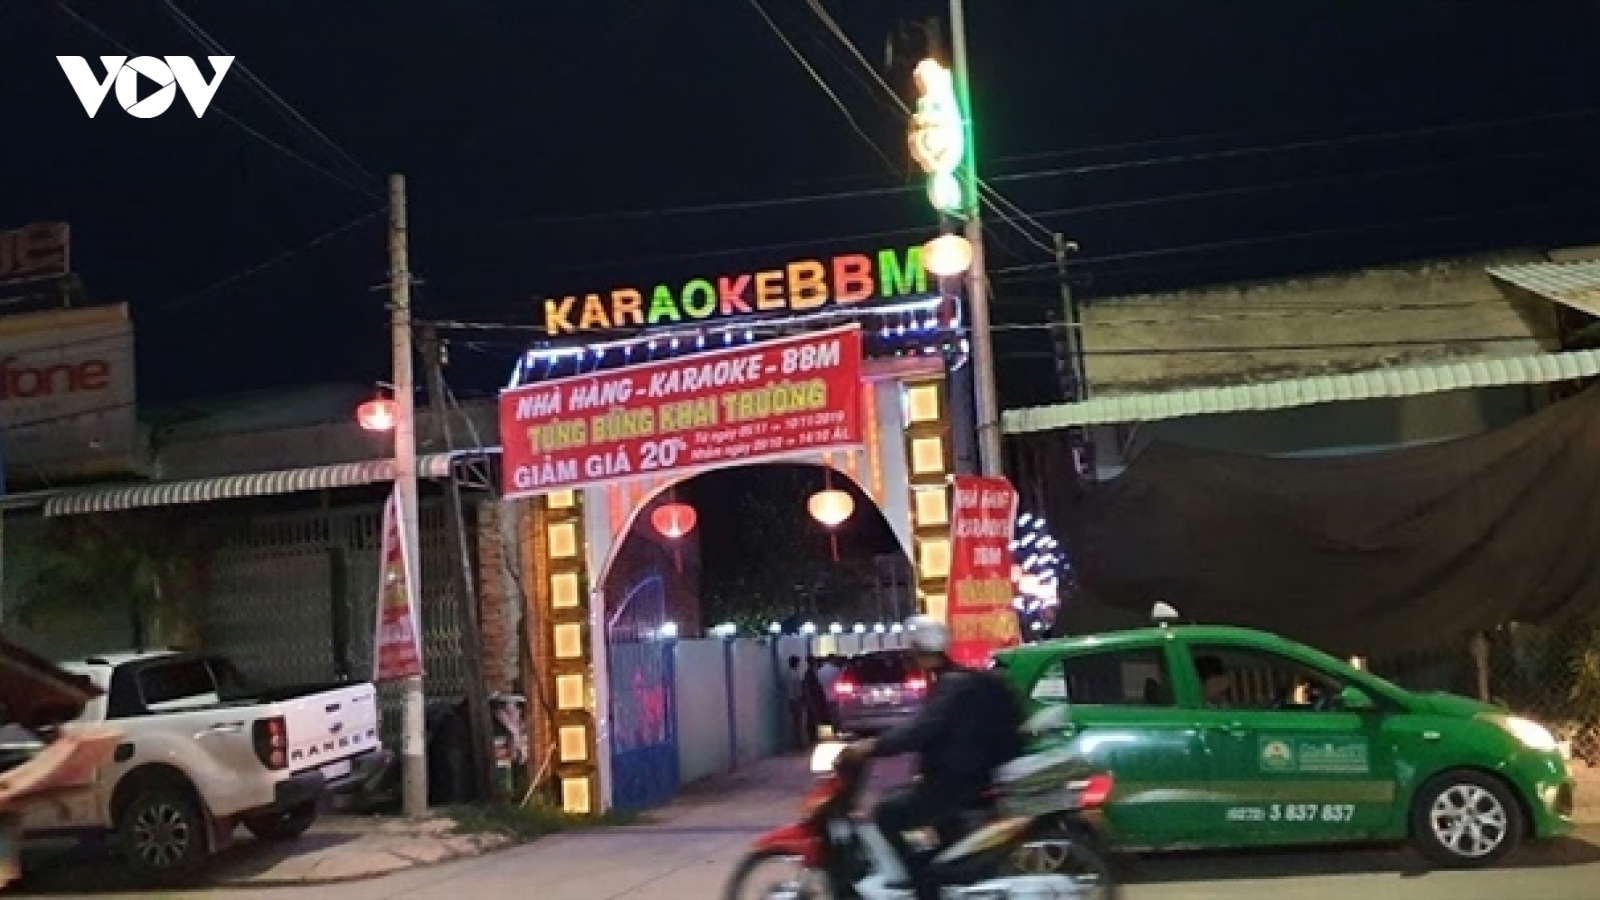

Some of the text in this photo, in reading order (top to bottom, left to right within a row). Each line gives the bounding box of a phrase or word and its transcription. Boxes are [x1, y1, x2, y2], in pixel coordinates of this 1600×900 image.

[516, 386, 562, 421] NHÀ
[569, 378, 633, 411] HÀNG
[649, 354, 765, 397] KARAOKE
[782, 339, 840, 374] BBM
[514, 455, 577, 488] GIẢM
[585, 444, 631, 477] GIÁ
[291, 728, 375, 760] RANGER
